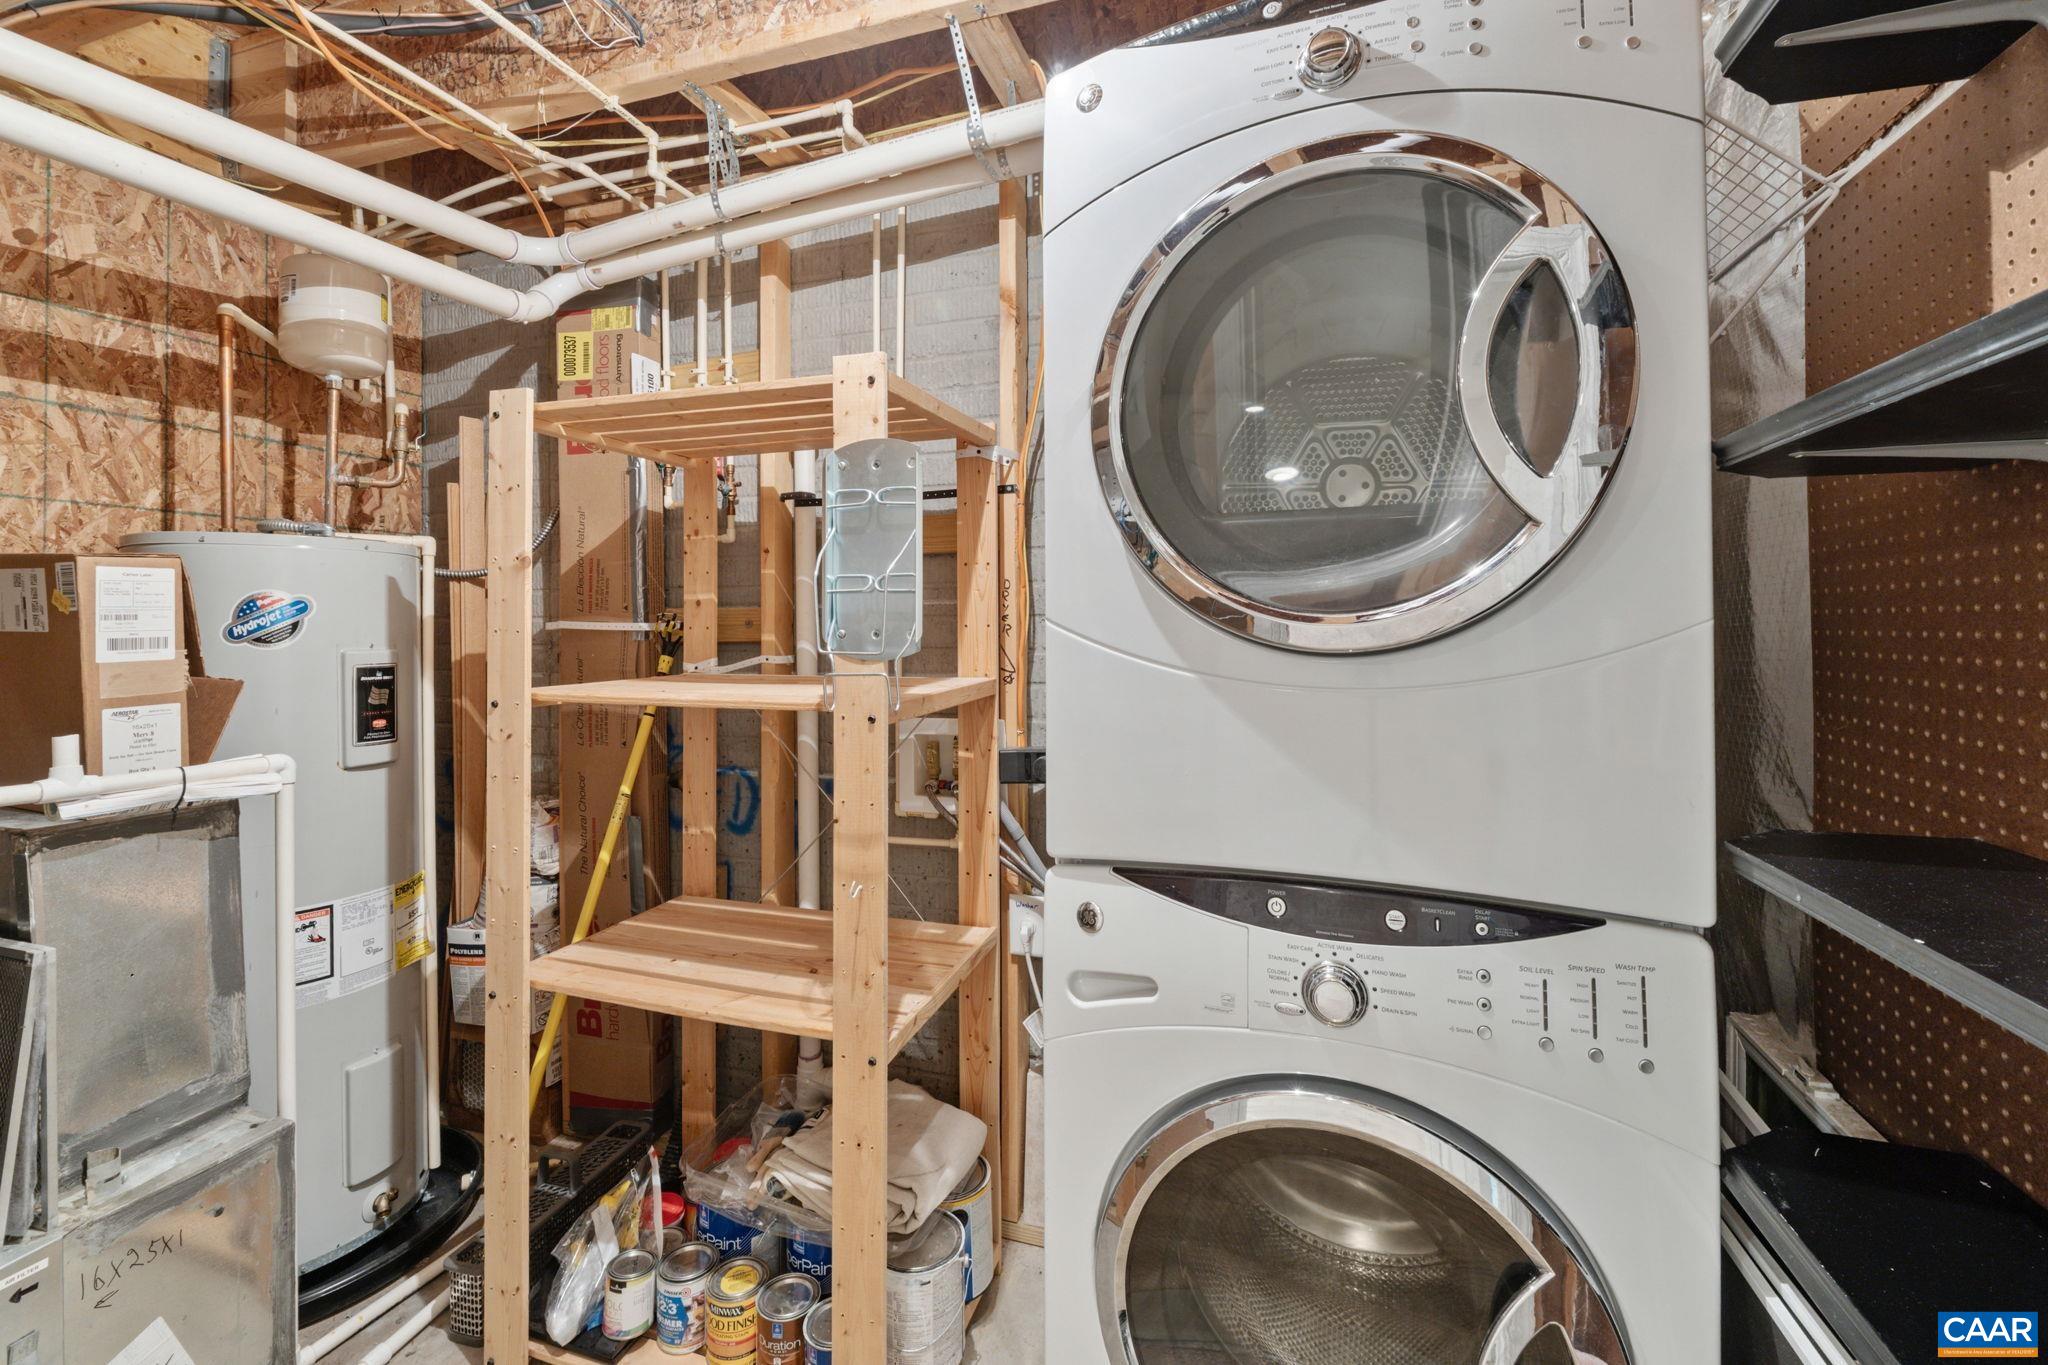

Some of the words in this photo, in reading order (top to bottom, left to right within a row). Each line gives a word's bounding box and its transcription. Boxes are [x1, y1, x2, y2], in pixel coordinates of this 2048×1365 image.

[596, 334, 610, 374] floors
[616, 334, 624, 384] Armstrong
[576, 599, 584, 613] La
[232, 609, 282, 637] Hydrojet
[576, 775, 587, 811] Choice
[576, 814, 588, 859] Natural
[1287, 944, 1300, 952] EASY
[1317, 942, 1335, 950] ACTIVE
[1336, 944, 1352, 952] WEAR
[1268, 954, 1281, 962] STAIN
[1282, 956, 1299, 964] WASH
[1356, 954, 1384, 962] DELICATES
[1519, 966, 1534, 974] SOIL
[1535, 968, 1554, 976] LEVEL
[1568, 964, 1583, 972] SPIN
[1584, 966, 1606, 974] SPEED
[1615, 964, 1636, 972] WASH
[1269, 975, 1290, 983] NORMAL
[1389, 970, 1407, 978] WASH
[1380, 988, 1396, 996] SPEED
[1398, 989, 1416, 997] WASH
[710, 1303, 744, 1317] MINWAX
[760, 1334, 801, 1350] Duration
